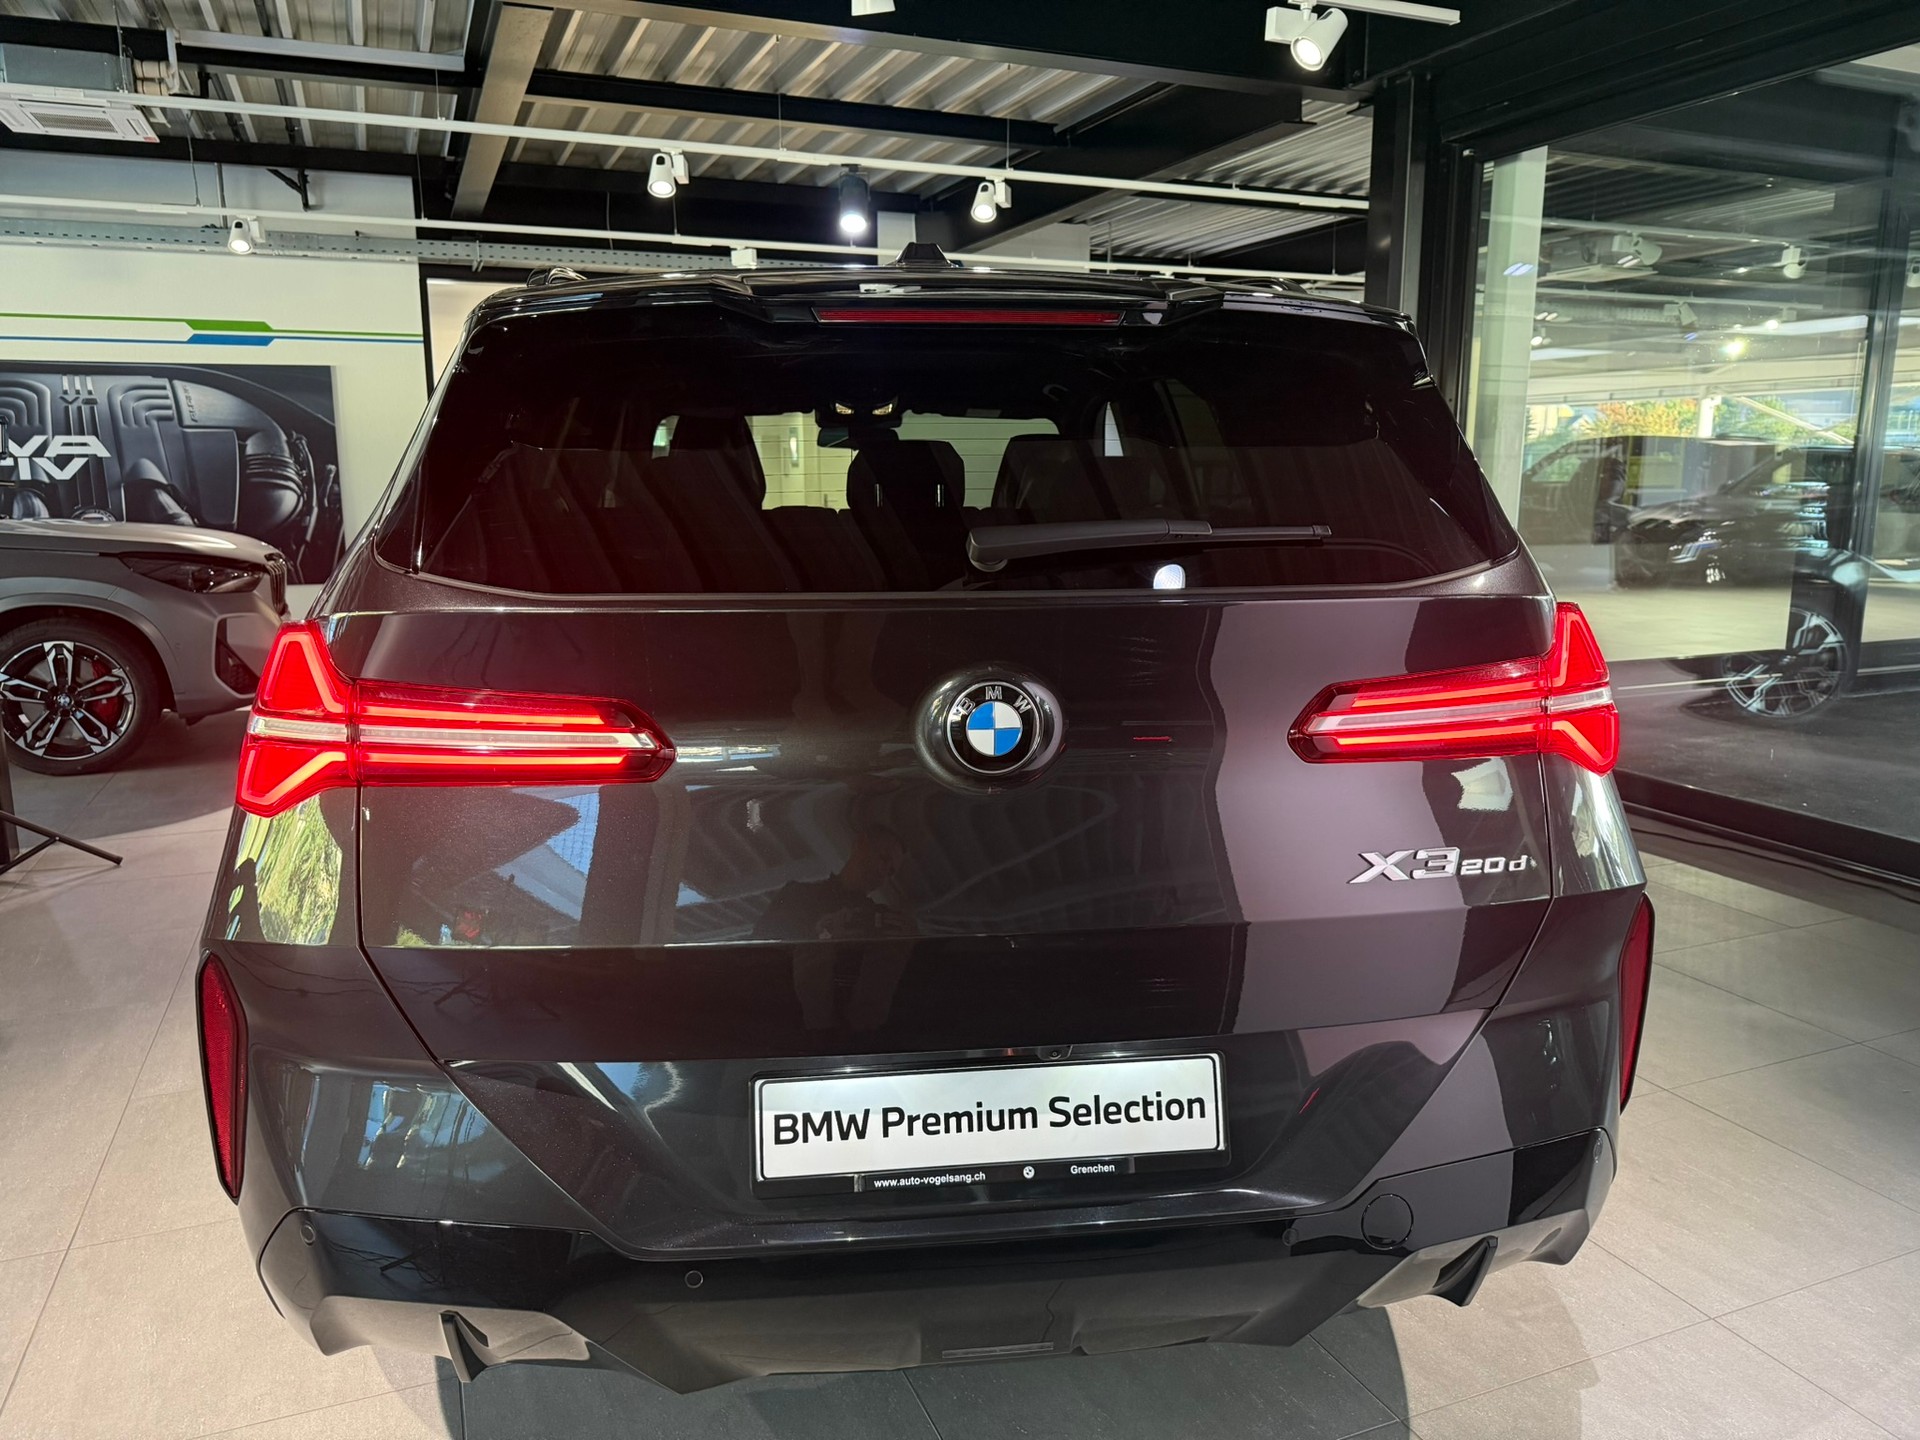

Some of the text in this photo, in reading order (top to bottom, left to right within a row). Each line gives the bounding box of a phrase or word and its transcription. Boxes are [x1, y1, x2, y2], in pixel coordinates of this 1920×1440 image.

[957, 686, 1032, 715] BMW
[773, 1090, 1207, 1146] BMW Premium Selection
[873, 1163, 1115, 1188] www.auto-vogelsang.ch Grenchen
